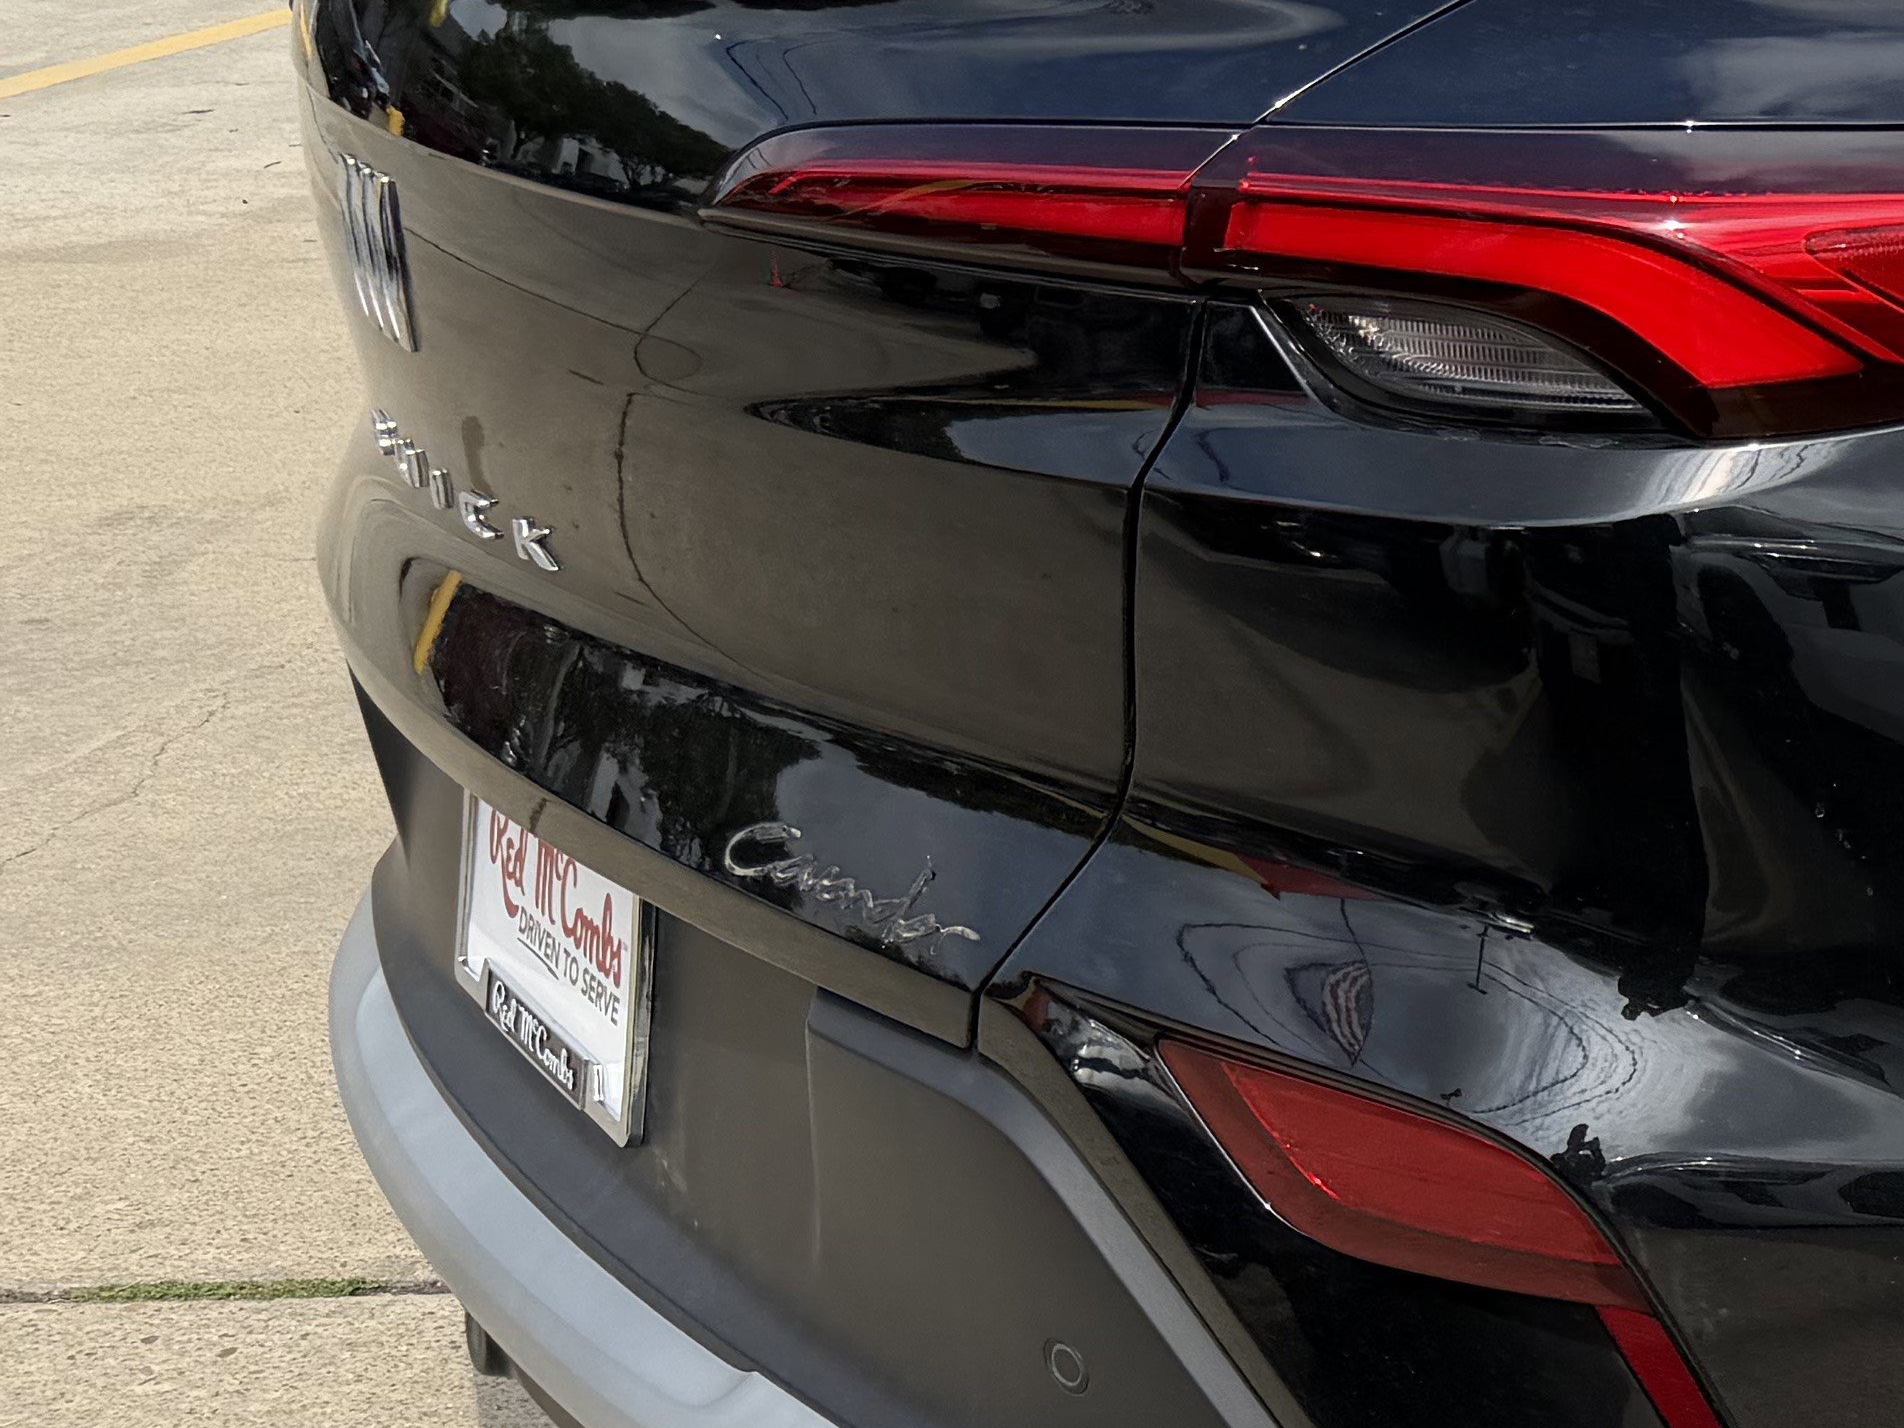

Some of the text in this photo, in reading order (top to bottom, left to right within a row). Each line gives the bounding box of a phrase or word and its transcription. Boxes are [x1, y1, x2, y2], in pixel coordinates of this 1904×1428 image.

[489, 808, 528, 919] Red
[518, 906, 622, 1026] DRIVEN TO SERVE
[490, 980, 575, 1092] Red McCombs
